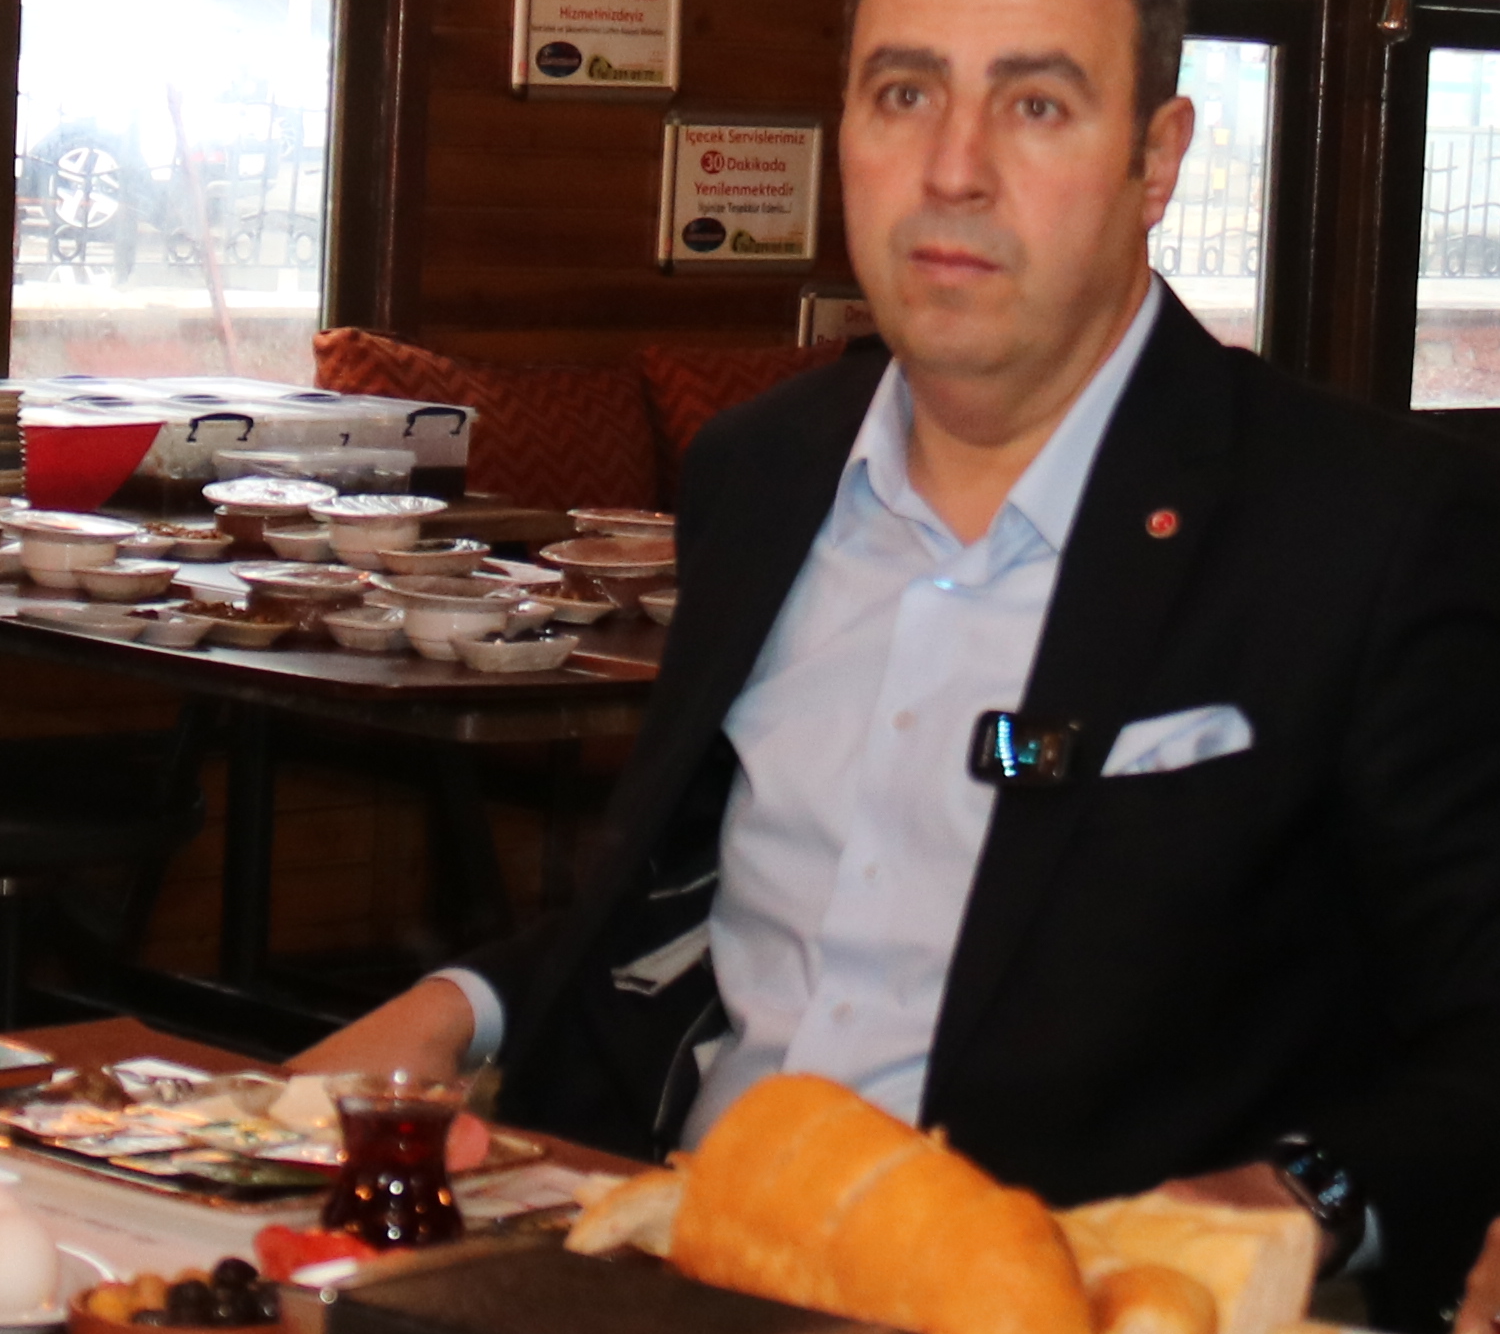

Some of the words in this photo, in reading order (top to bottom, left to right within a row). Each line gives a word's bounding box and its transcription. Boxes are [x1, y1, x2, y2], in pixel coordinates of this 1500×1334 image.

[560, 6, 644, 23] Hizmetinizdeyiz
[728, 129, 806, 145] Servislerimiz
[704, 152, 723, 171] 30
[727, 156, 786, 172] Dakikada
[694, 181, 794, 196] Yenilenmektedir
